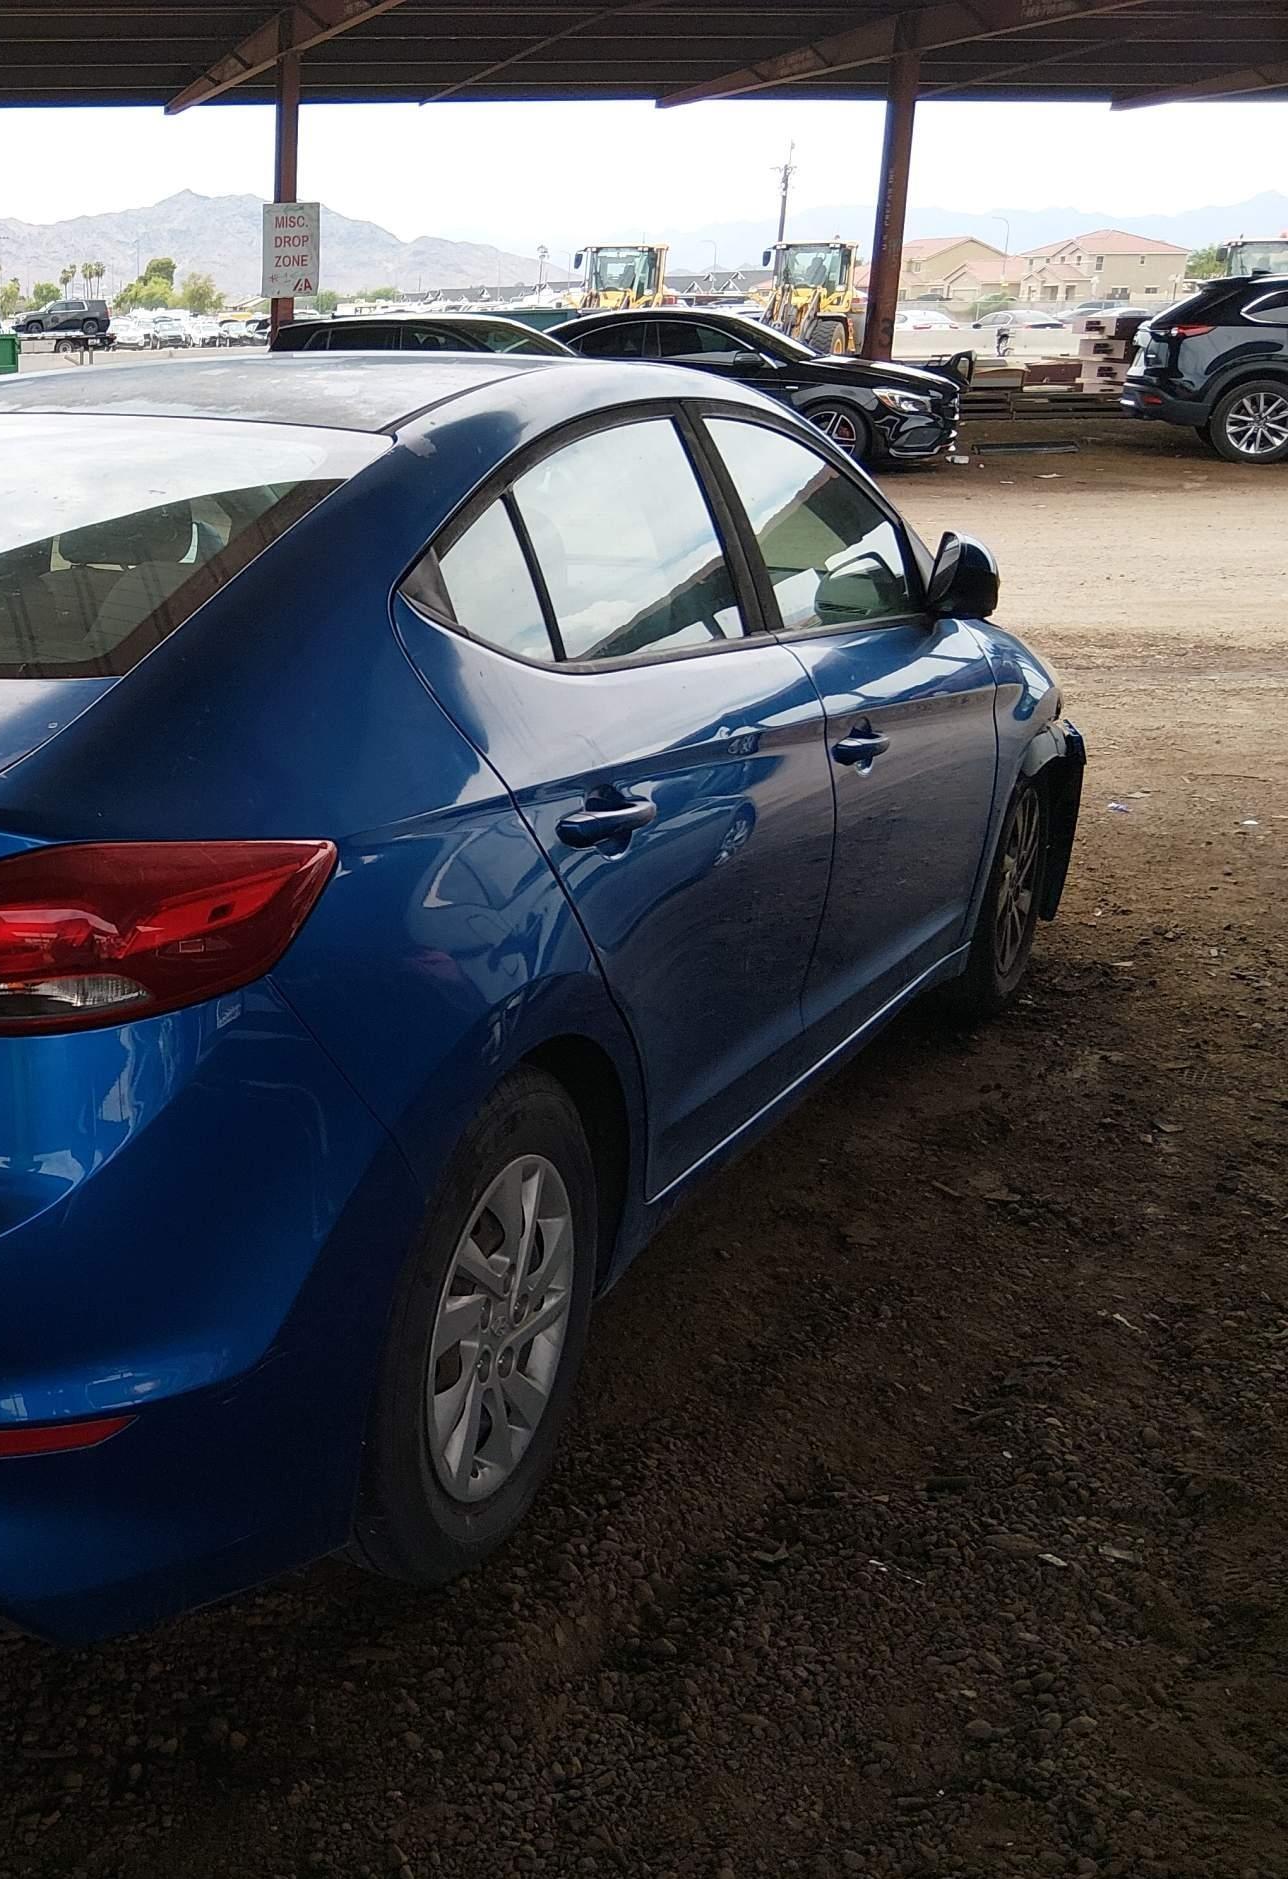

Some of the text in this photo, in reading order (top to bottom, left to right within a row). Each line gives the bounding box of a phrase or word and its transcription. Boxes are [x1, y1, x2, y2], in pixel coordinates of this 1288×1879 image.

[274, 215, 309, 228] MISC.
[274, 235, 309, 248] DROP
[274, 255, 309, 268] ZONE
